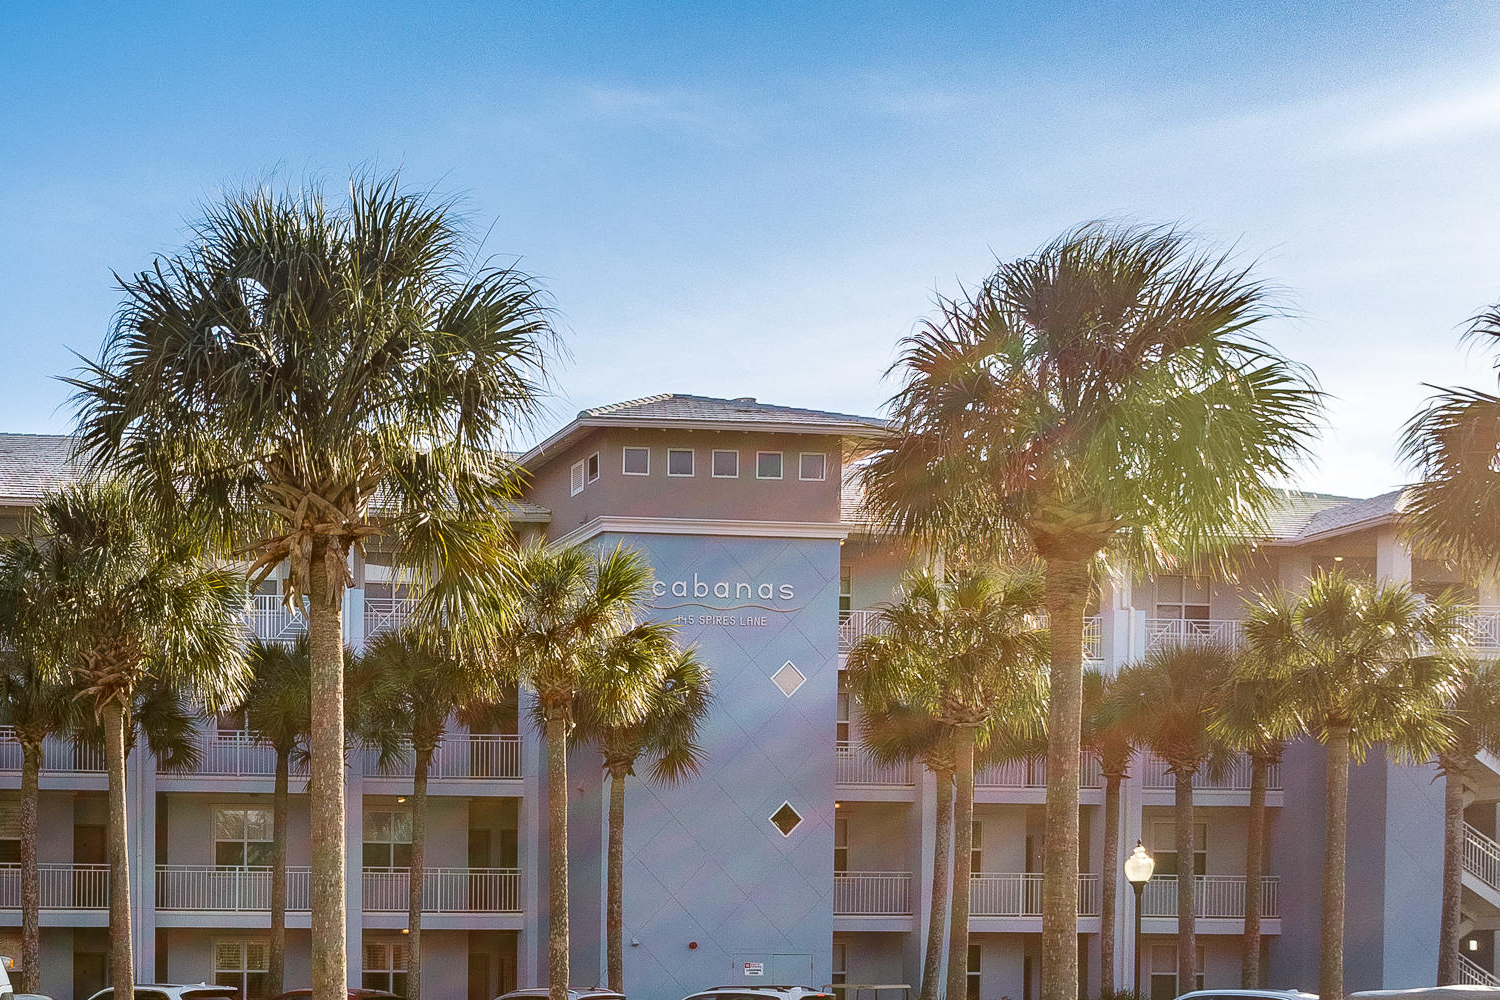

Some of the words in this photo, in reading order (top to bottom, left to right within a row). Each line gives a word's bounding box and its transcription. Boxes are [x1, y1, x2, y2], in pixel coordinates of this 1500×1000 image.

[652, 573, 796, 601] cabanas
[699, 615, 736, 626] SPIRES
[740, 616, 768, 627] LANE
